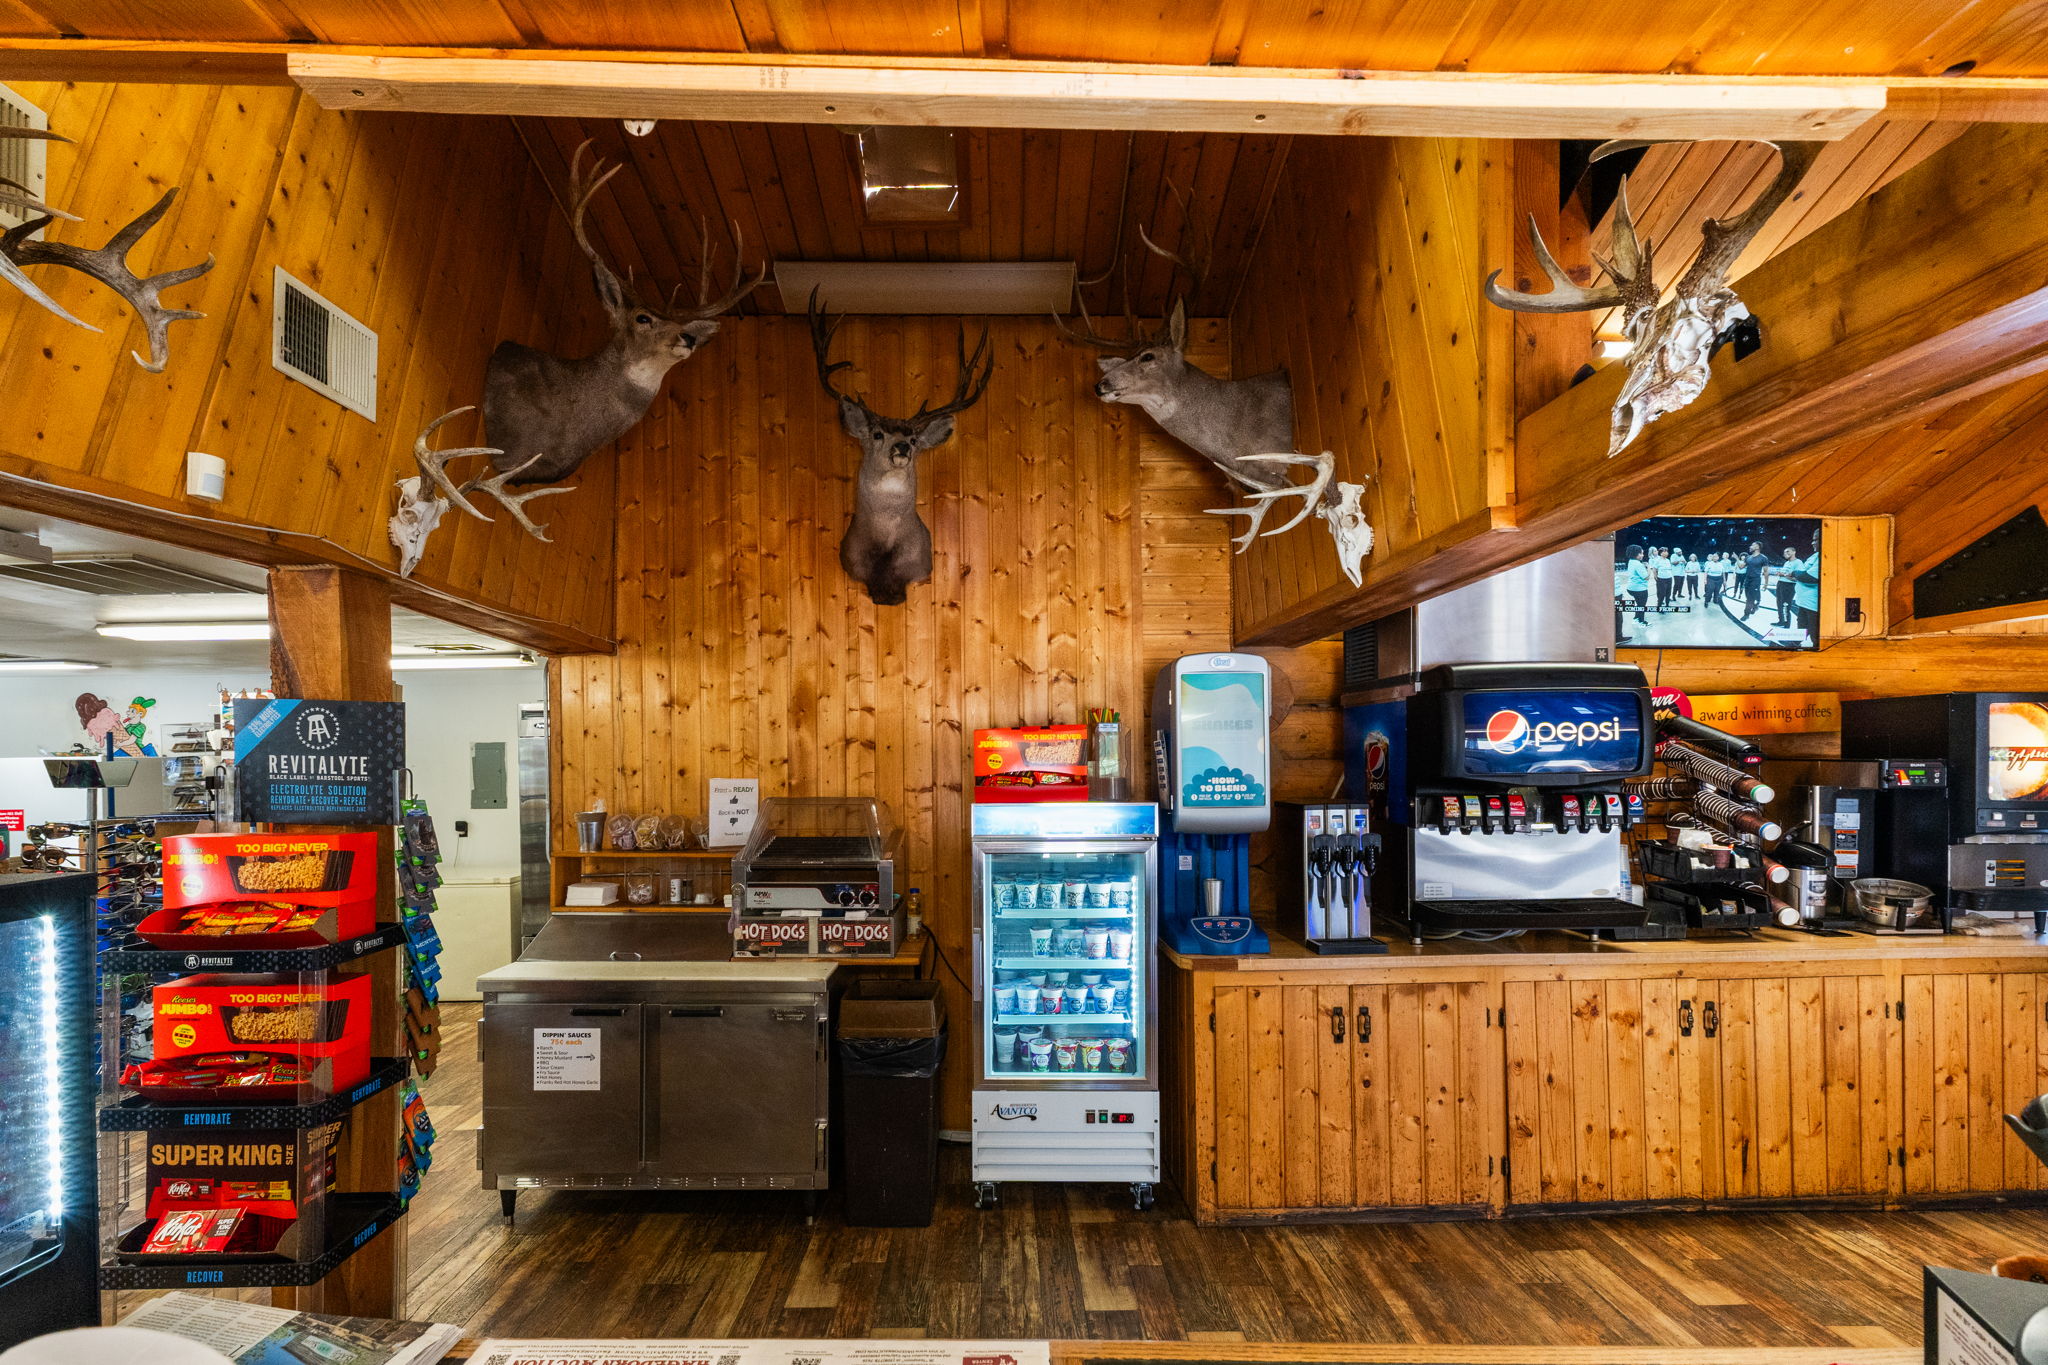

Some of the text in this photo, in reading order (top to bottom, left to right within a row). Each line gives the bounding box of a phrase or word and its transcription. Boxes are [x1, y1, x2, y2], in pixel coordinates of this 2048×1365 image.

[1652, 694, 1680, 707] ava
[1700, 704, 1832, 722] award winning coffees
[1534, 716, 1620, 746] pepsi
[268, 754, 368, 775] REVITALYTE
[270, 784, 367, 795] ELECTROLYTE SOLUTION
[1370, 781, 1385, 792] pepsi
[270, 796, 366, 805] REHYDRATE RECOVER REPEAT
[236, 843, 331, 853] TOO BIG? NEVER.
[740, 923, 805, 940] HOT DOGS
[822, 924, 888, 940] HOT DOGS
[201, 957, 233, 965] REVITALYTE
[230, 994, 253, 1003] TOO
[257, 994, 281, 1003] BIG?
[159, 1004, 208, 1015] JUMBO
[351, 1078, 381, 1102] REHYDRATE
[990, 1103, 1037, 1116] AVANTCO
[184, 1113, 231, 1125] REHYDRATE
[151, 1144, 294, 1166] SUPER KING SIZE
[353, 1222, 377, 1248] RECOVER
[187, 1271, 223, 1283] RECOVER
